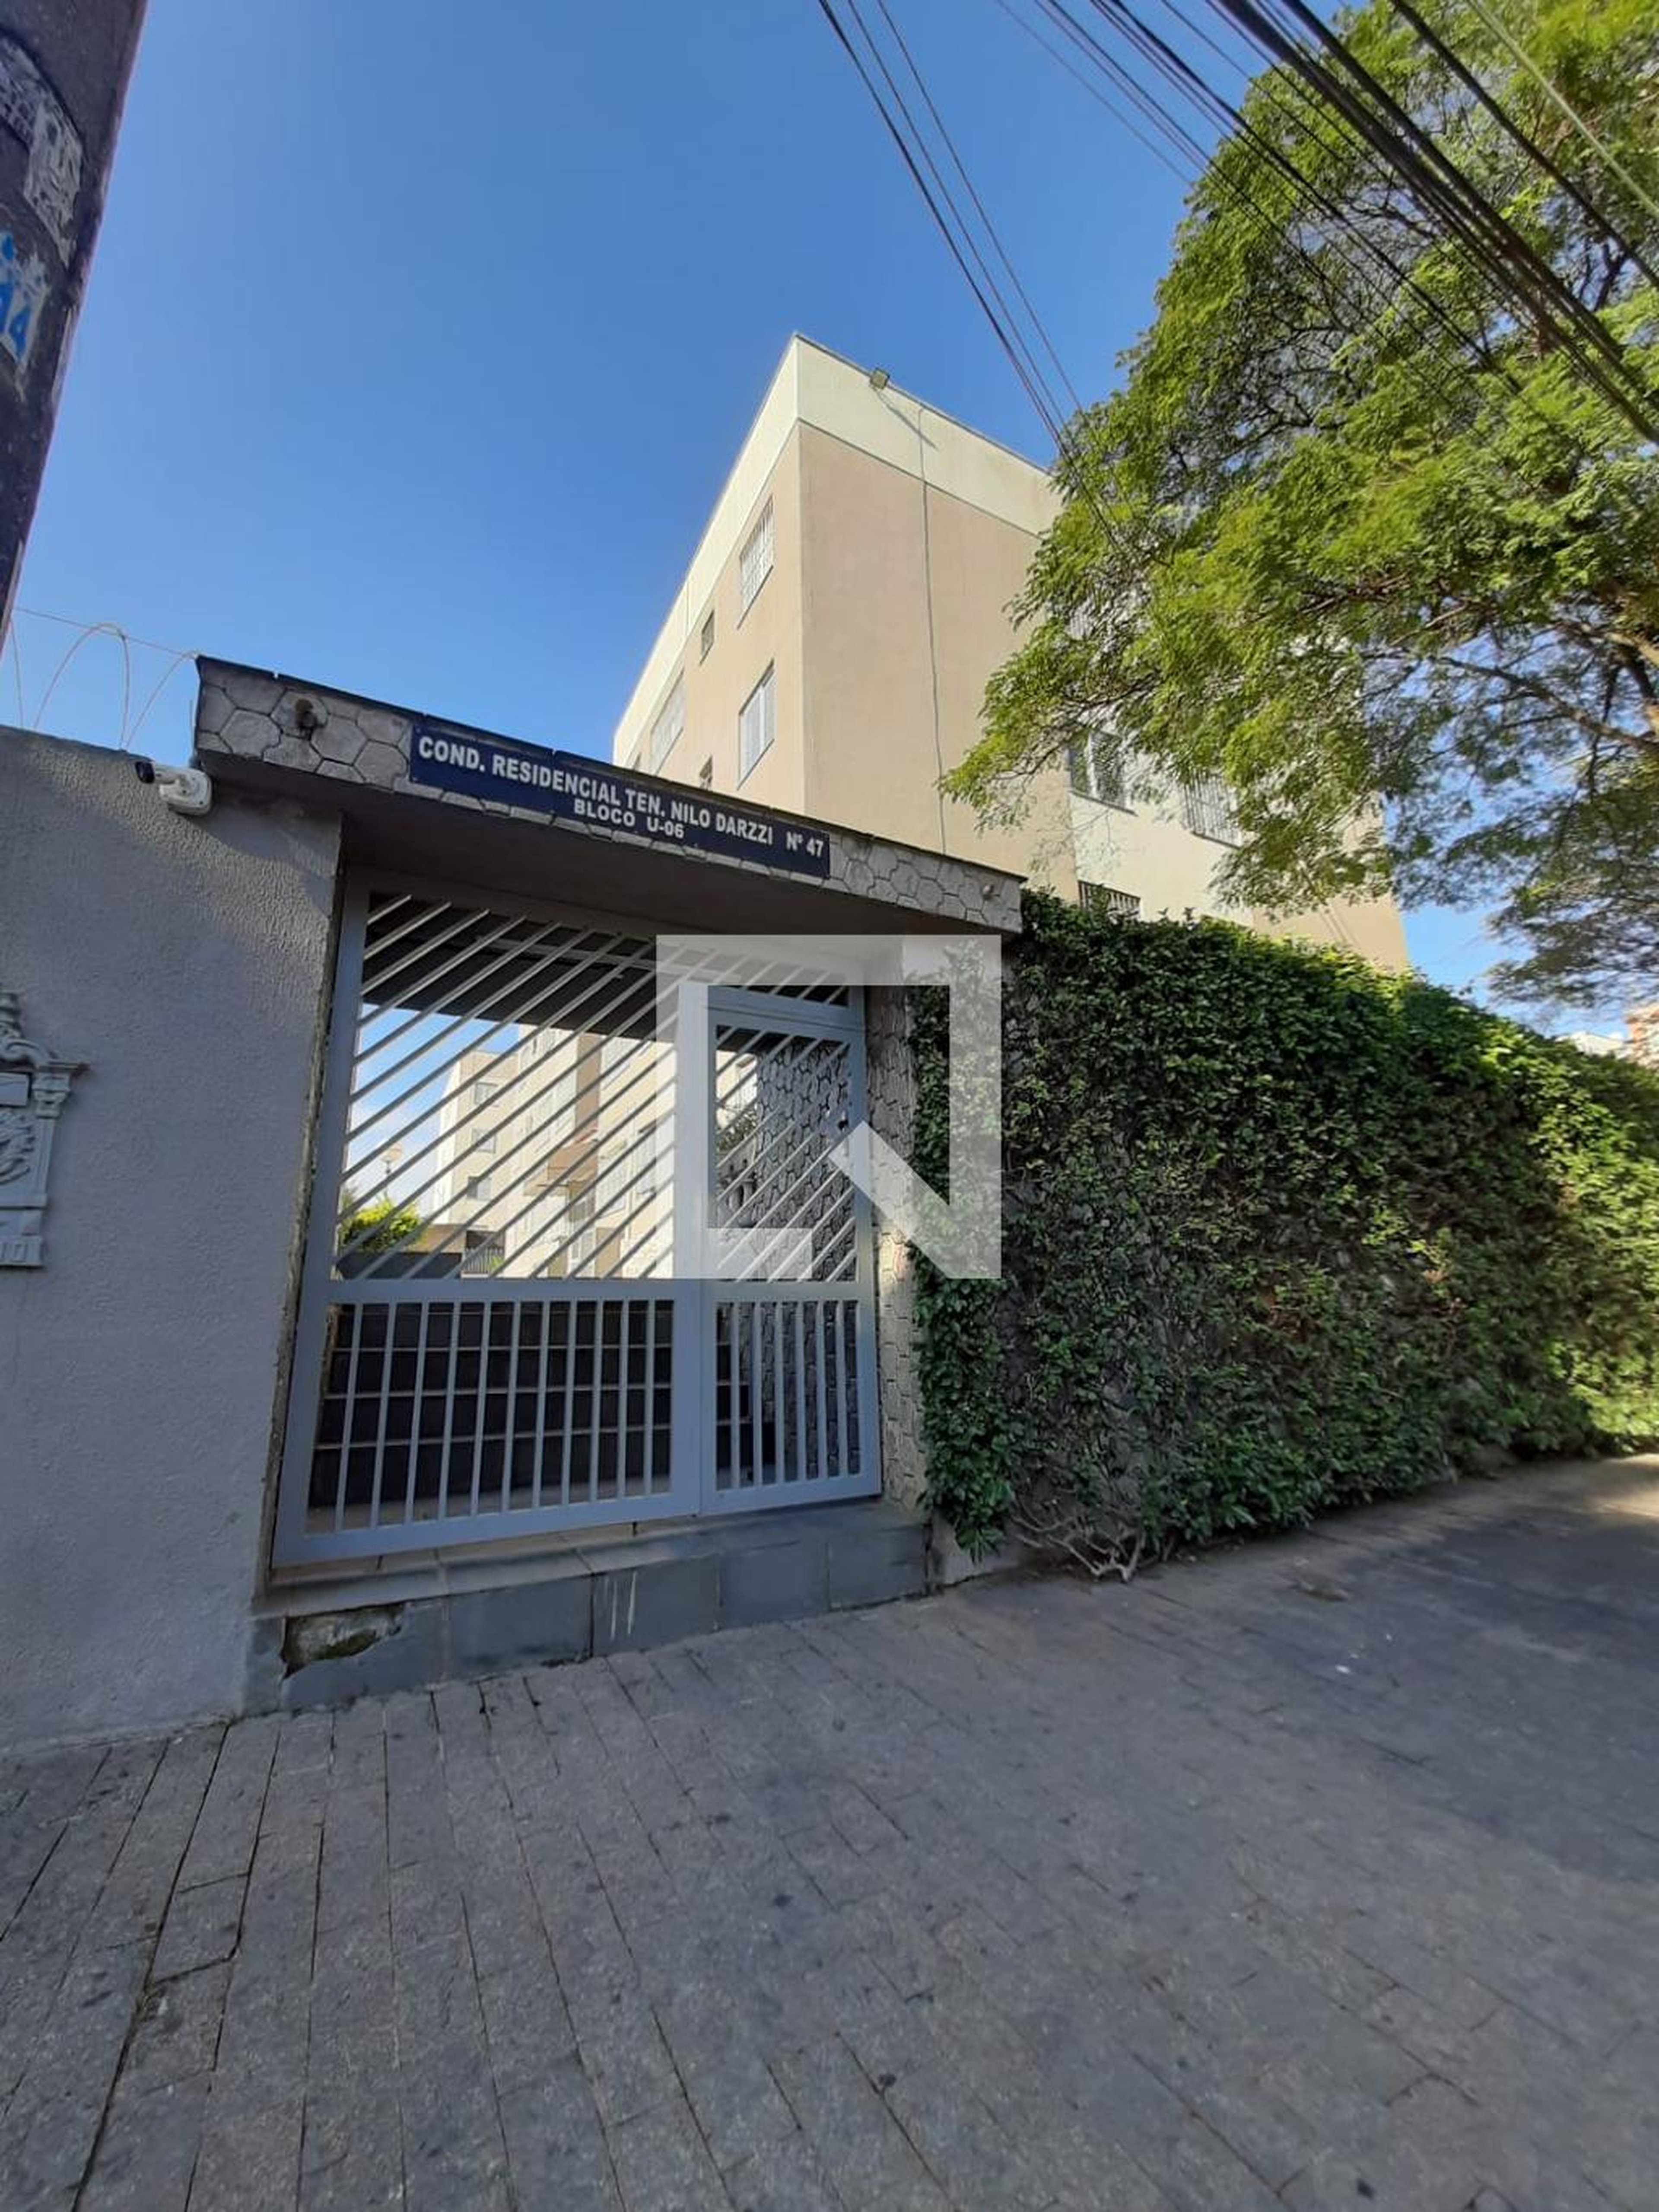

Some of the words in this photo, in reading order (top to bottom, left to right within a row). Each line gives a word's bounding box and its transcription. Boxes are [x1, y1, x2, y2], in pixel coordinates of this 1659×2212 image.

[419, 736, 486, 773] COND.
[492, 754, 621, 806] RESIDENCIAL
[625, 789, 665, 818] TEN.
[671, 800, 711, 828] NILO
[715, 812, 773, 845] DARZZI
[806, 837, 824, 858] 47
[574, 798, 636, 827] BLOCO
[647, 816, 684, 839] U-06
